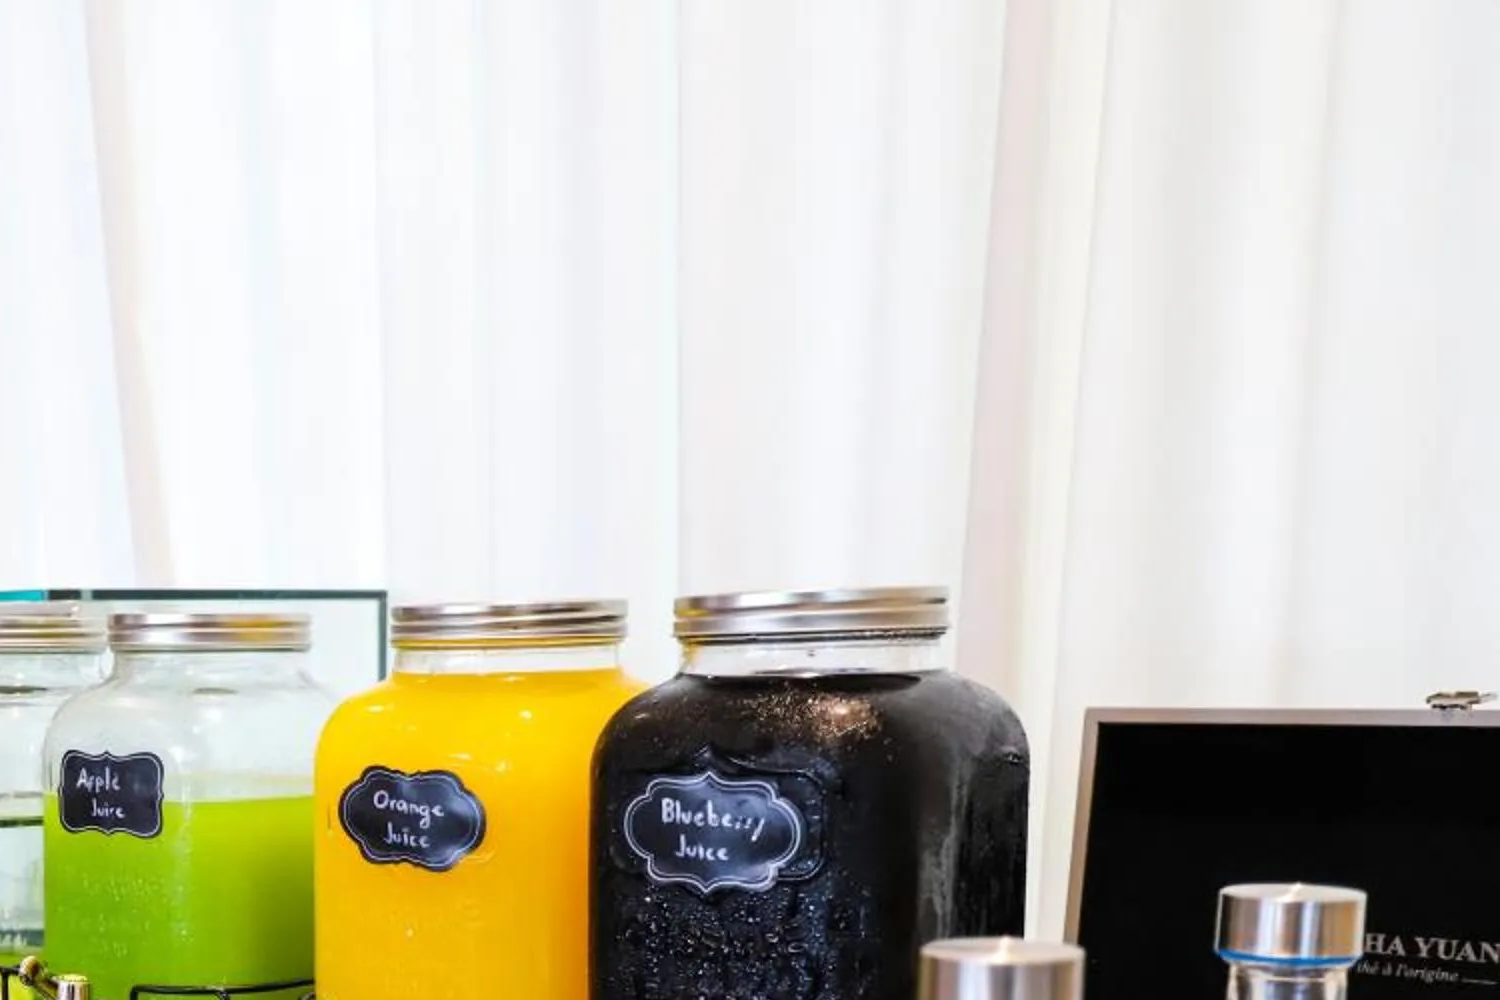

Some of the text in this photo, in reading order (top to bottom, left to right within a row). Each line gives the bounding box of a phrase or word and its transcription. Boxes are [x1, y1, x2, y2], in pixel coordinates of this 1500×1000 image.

[76, 766, 121, 793] Apple
[373, 790, 444, 829] Orange
[661, 797, 765, 842] Blueberry
[384, 821, 430, 848] Juice
[675, 834, 729, 861] Juice
[1364, 932, 1500, 963] HA YUAN
